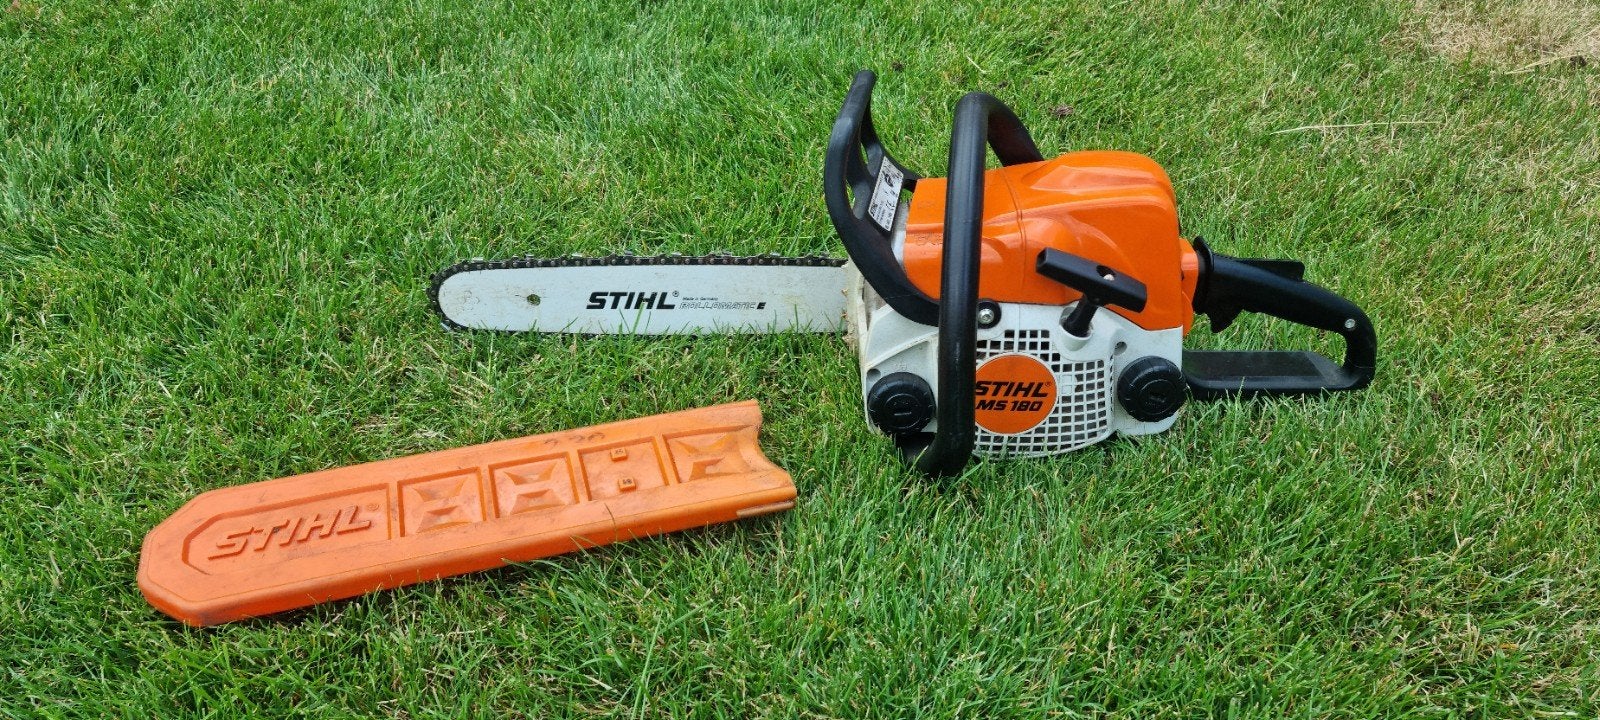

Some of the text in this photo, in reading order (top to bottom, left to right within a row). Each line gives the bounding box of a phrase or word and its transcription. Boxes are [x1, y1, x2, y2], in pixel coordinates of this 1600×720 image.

[586, 291, 676, 310] STIHL
[679, 301, 767, 310] ROLLOMATIC E
[975, 380, 1049, 398] STIHL
[975, 399, 1044, 412] MS 180
[207, 504, 373, 562] STIHL
